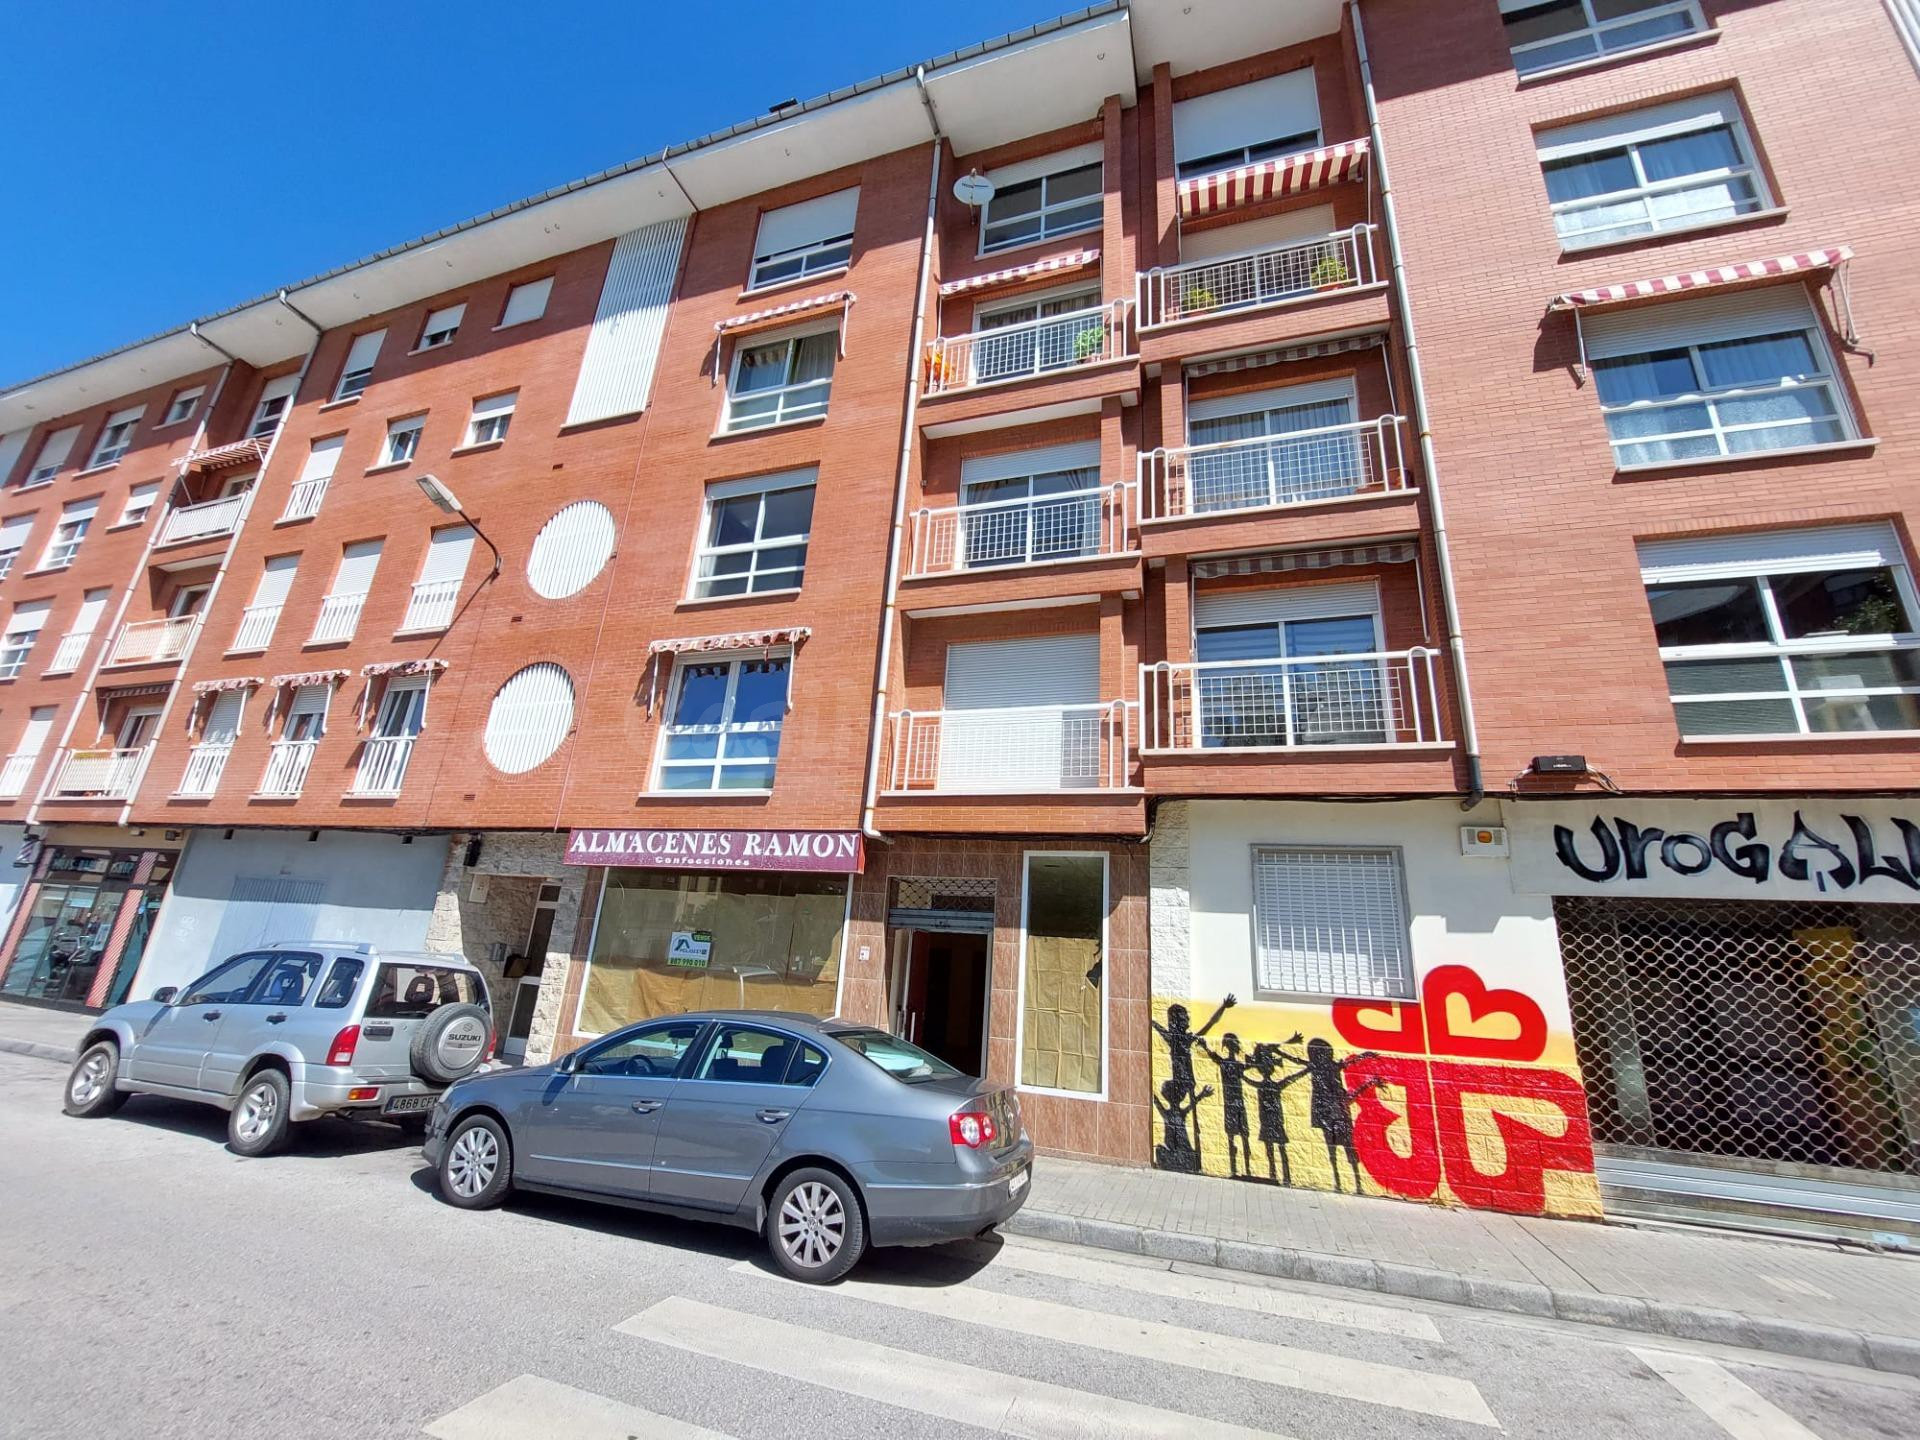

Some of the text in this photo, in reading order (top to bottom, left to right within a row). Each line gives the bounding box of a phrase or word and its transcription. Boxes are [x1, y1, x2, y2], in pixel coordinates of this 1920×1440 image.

[570, 831, 858, 858] ALMACENES RAMON
[654, 856, 750, 867] Confecciones
[448, 1033, 481, 1042] SUZUKI
[394, 1098, 419, 1110] 4868
